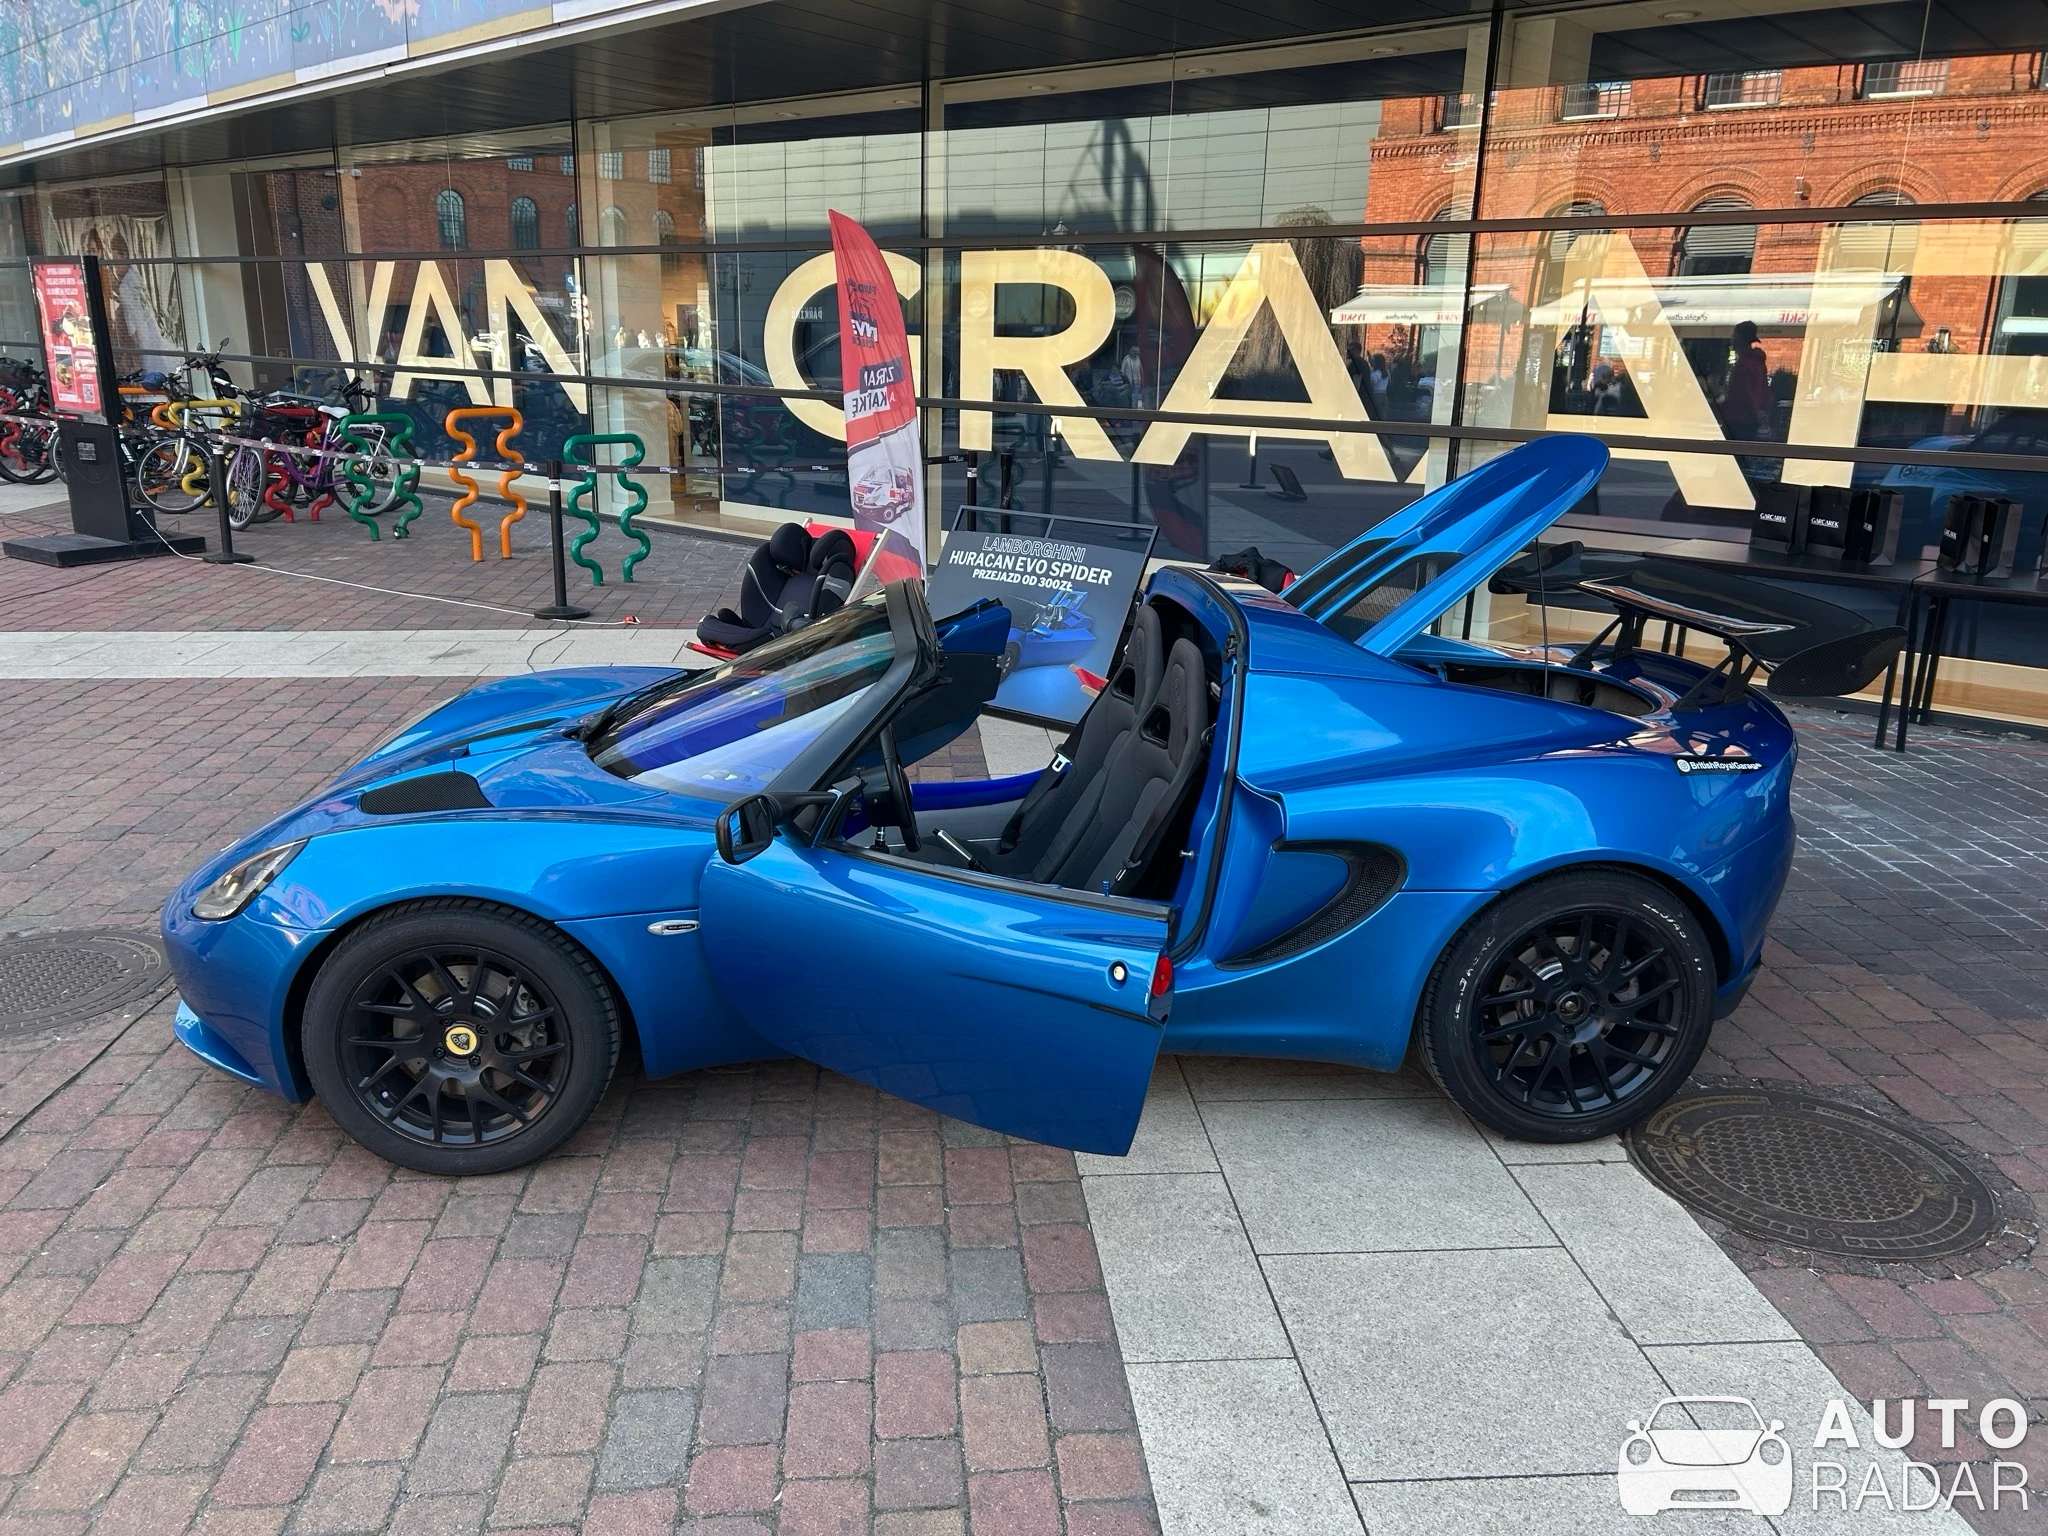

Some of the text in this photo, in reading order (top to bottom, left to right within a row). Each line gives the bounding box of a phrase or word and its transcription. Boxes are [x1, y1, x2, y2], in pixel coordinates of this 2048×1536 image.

[305, 258, 587, 414] VAN
[982, 536, 1086, 563] LAMBORGHINI
[949, 550, 1113, 585] HURACAN EVO SPIDER
[972, 568, 1022, 584] PRZEJAZD
[1022, 574, 1038, 586] OD
